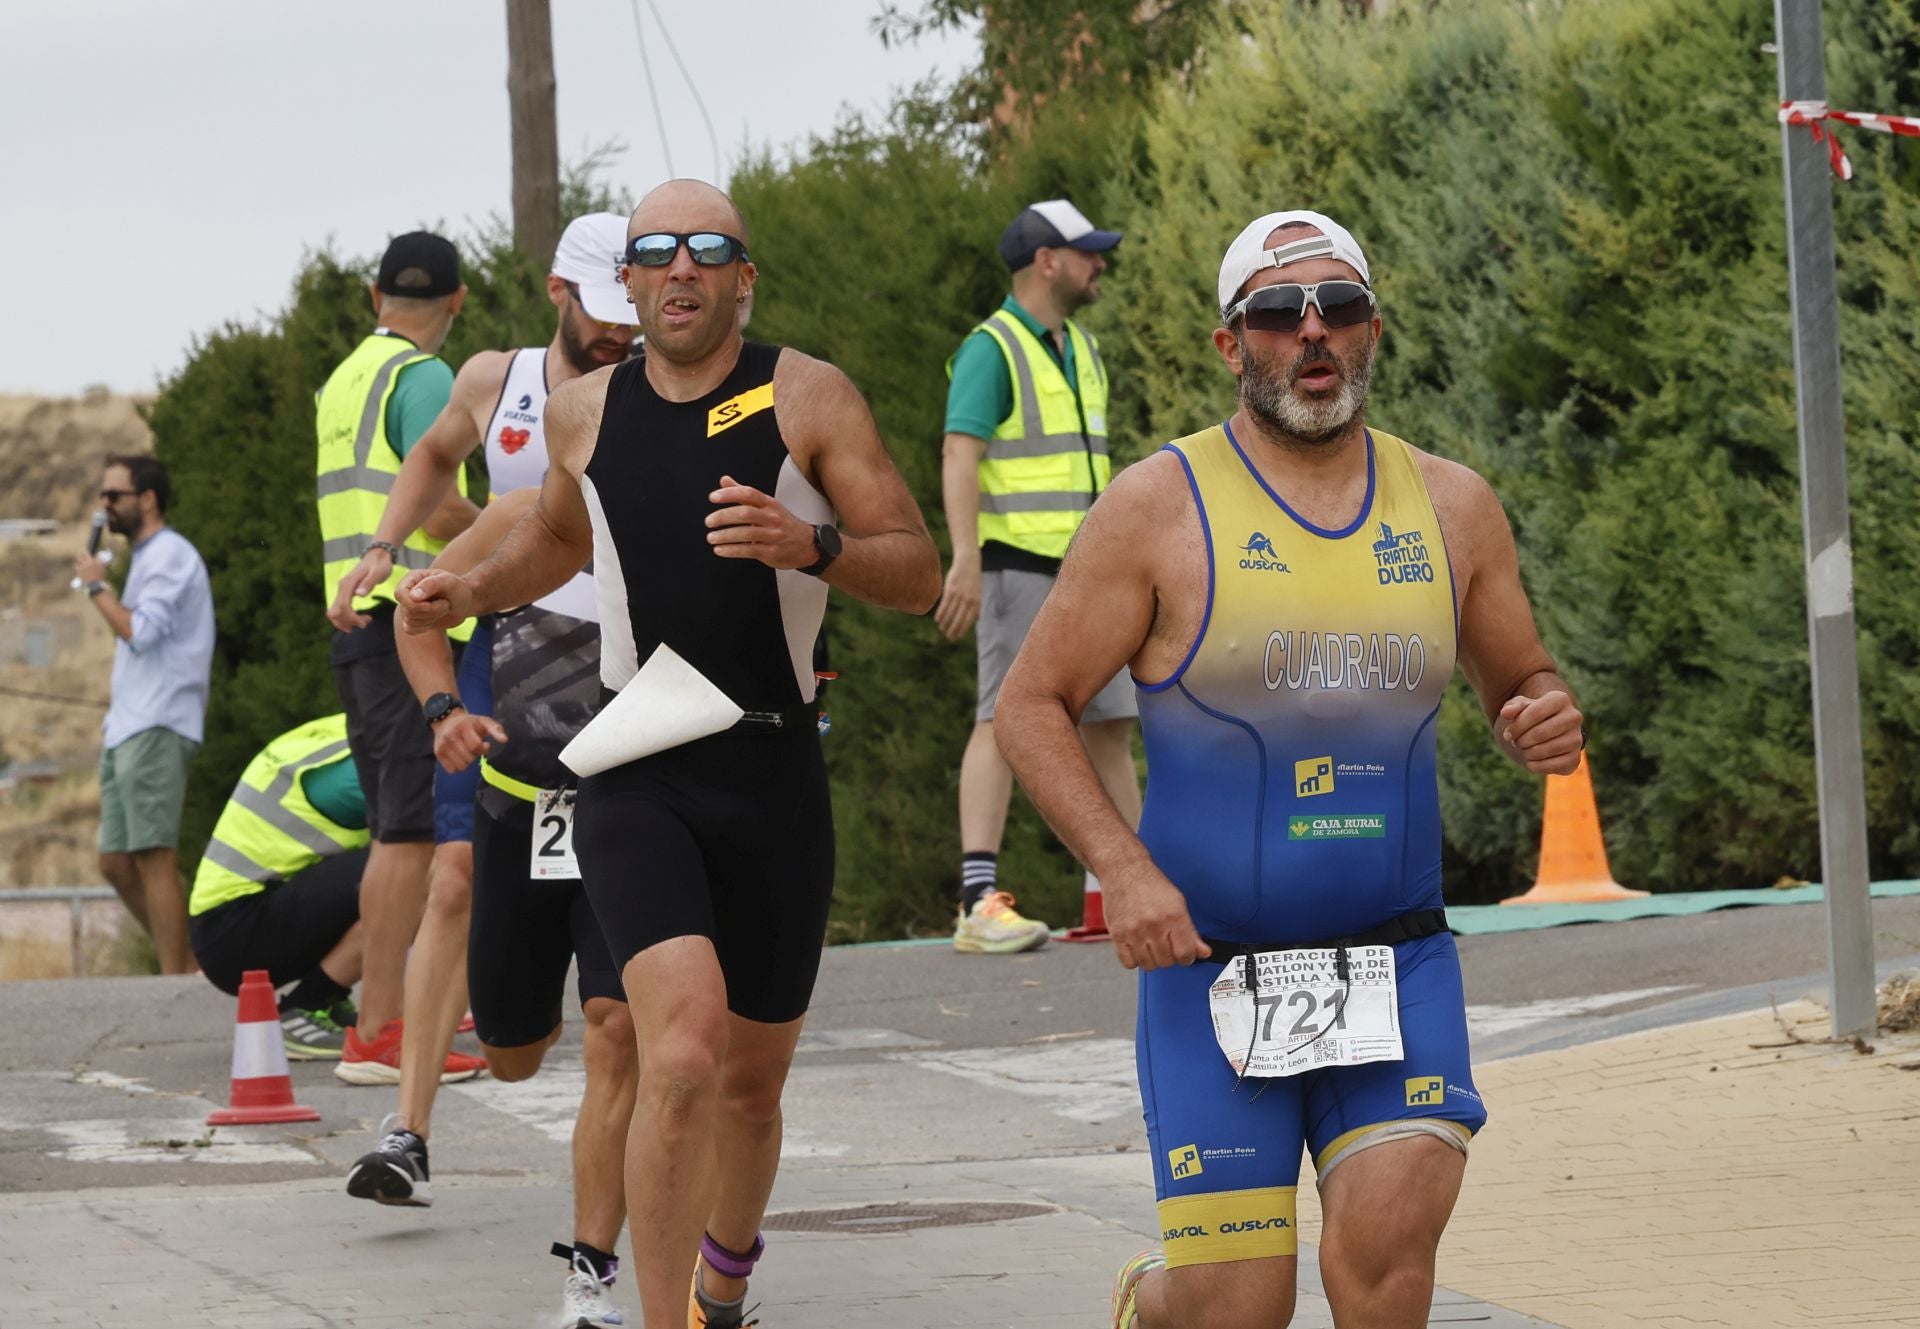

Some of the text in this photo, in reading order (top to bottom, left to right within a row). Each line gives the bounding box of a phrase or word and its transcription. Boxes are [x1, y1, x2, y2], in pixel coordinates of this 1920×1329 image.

[1374, 544, 1429, 567] TRIATLON
[1239, 558, 1292, 574] austral
[1377, 562, 1434, 585] DUERO
[1263, 630, 1425, 691] CUADRADO
[1312, 818, 1382, 829] CAJA RURAL
[1236, 948, 1389, 968] FDERACION DE
[1236, 963, 1314, 979] TIATLON
[1318, 962, 1328, 971] Y
[1367, 959, 1390, 968] DE
[1349, 970, 1389, 980] EON
[1253, 988, 1347, 1041] 721
[1247, 1061, 1277, 1070] Castilla
[1219, 1217, 1290, 1234] austral
